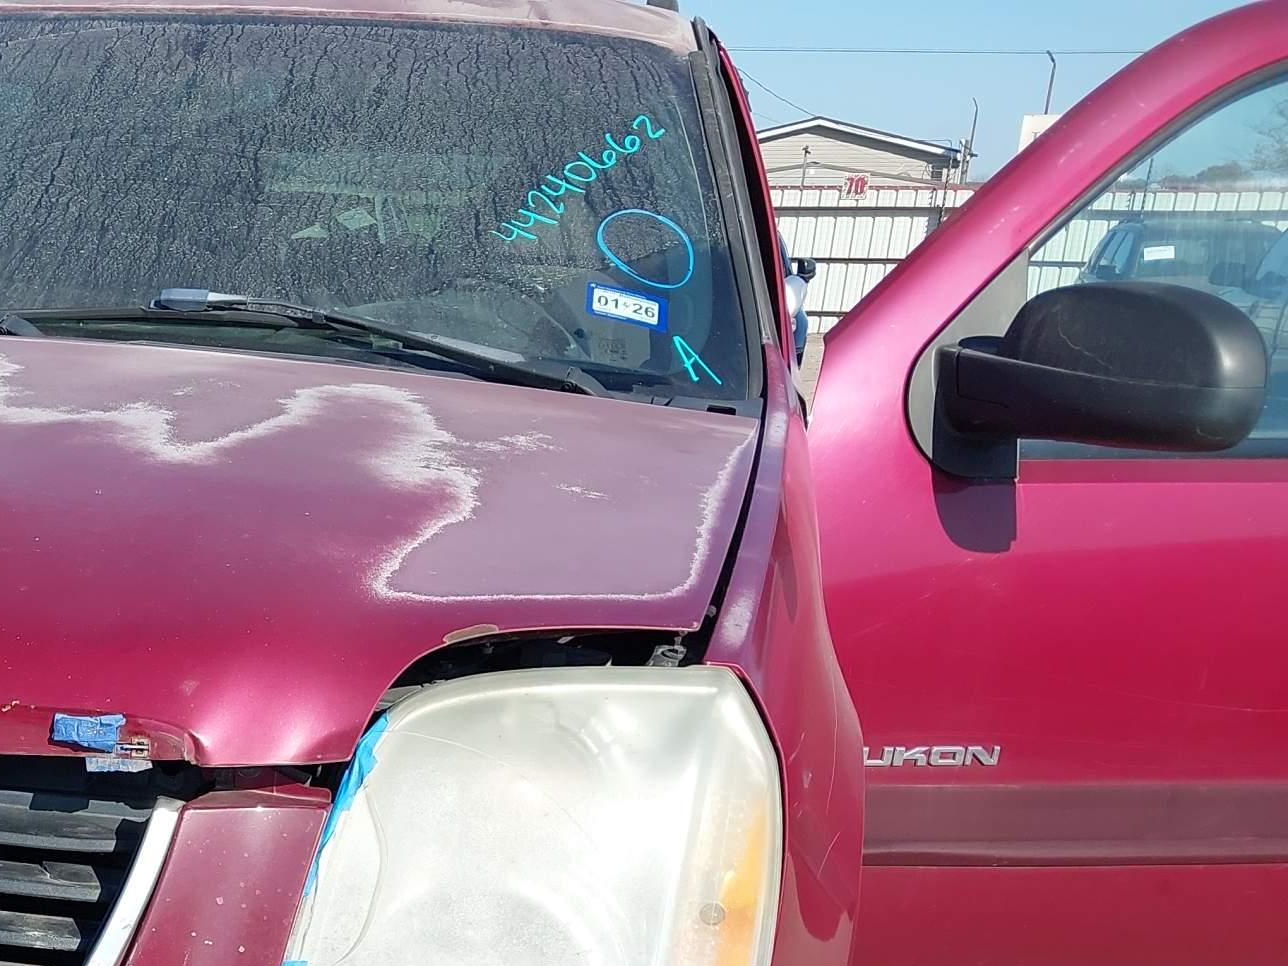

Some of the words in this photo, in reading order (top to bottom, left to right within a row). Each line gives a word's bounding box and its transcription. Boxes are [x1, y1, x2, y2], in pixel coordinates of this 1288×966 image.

[489, 114, 666, 242] 44240662
[597, 295, 619, 310] 01
[632, 303, 656, 318] 26
[673, 336, 723, 385] A
[863, 745, 1001, 767] UKON
